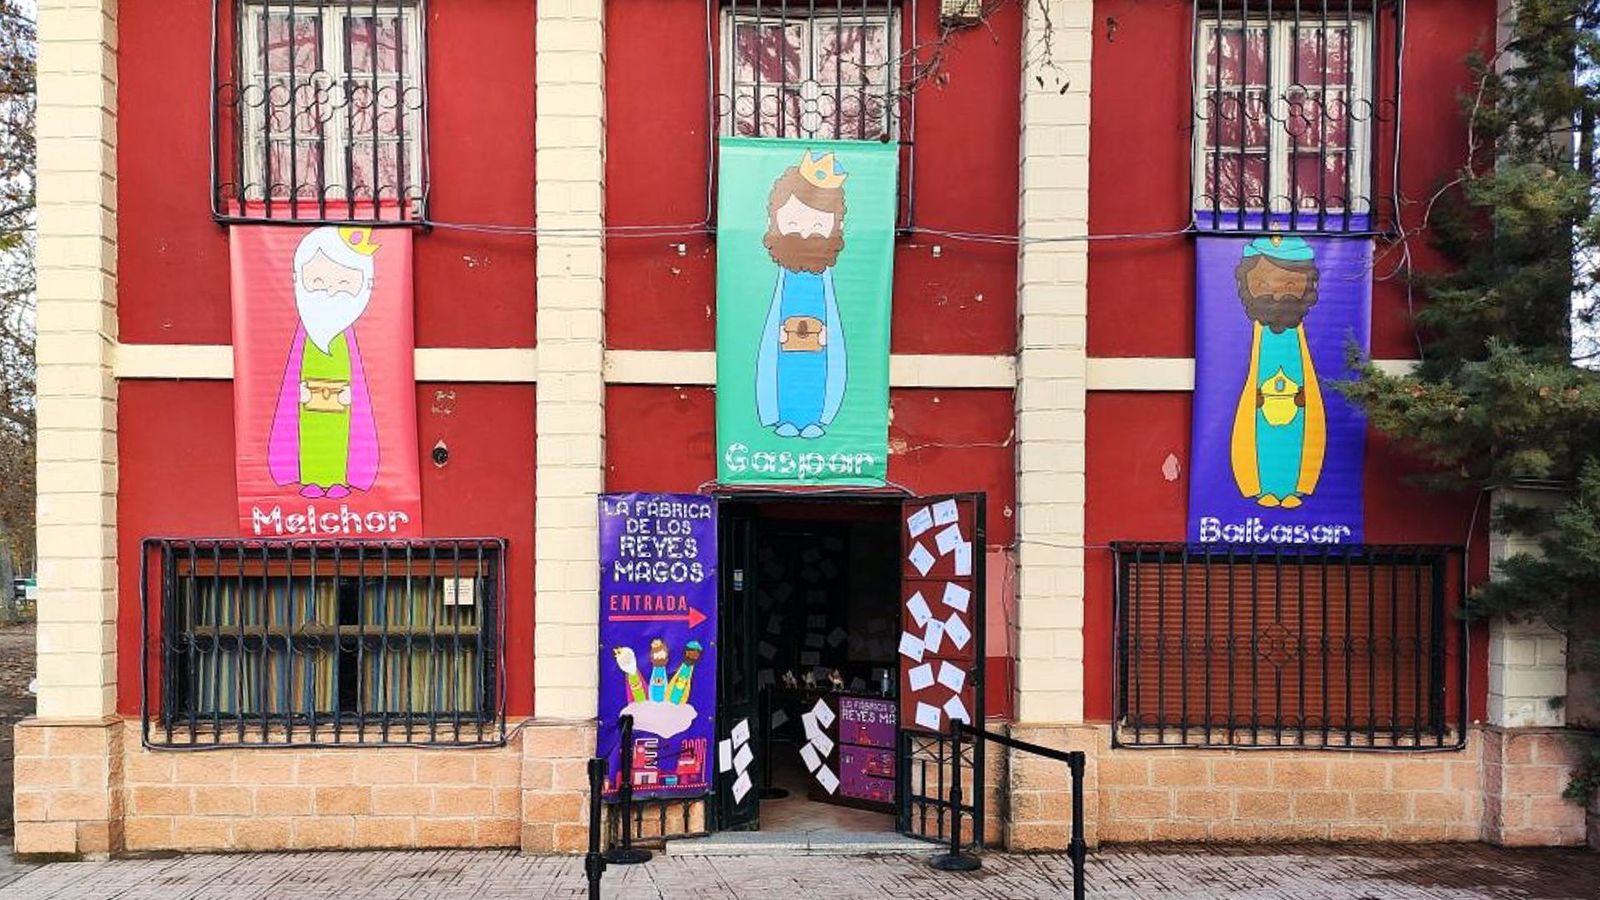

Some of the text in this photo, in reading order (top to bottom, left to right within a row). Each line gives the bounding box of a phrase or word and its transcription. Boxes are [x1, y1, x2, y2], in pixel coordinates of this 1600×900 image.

[725, 442, 874, 480] Gaspar
[252, 504, 409, 535] Melchor
[604, 497, 711, 519] LA FÁBRICA
[626, 518, 692, 535] DE LOS
[1200, 516, 1351, 543] Baltasar
[620, 535, 698, 559] REYES
[614, 560, 705, 583] MAGOS
[610, 595, 687, 611] ENTRADA
[842, 709, 897, 725] REYES MA
